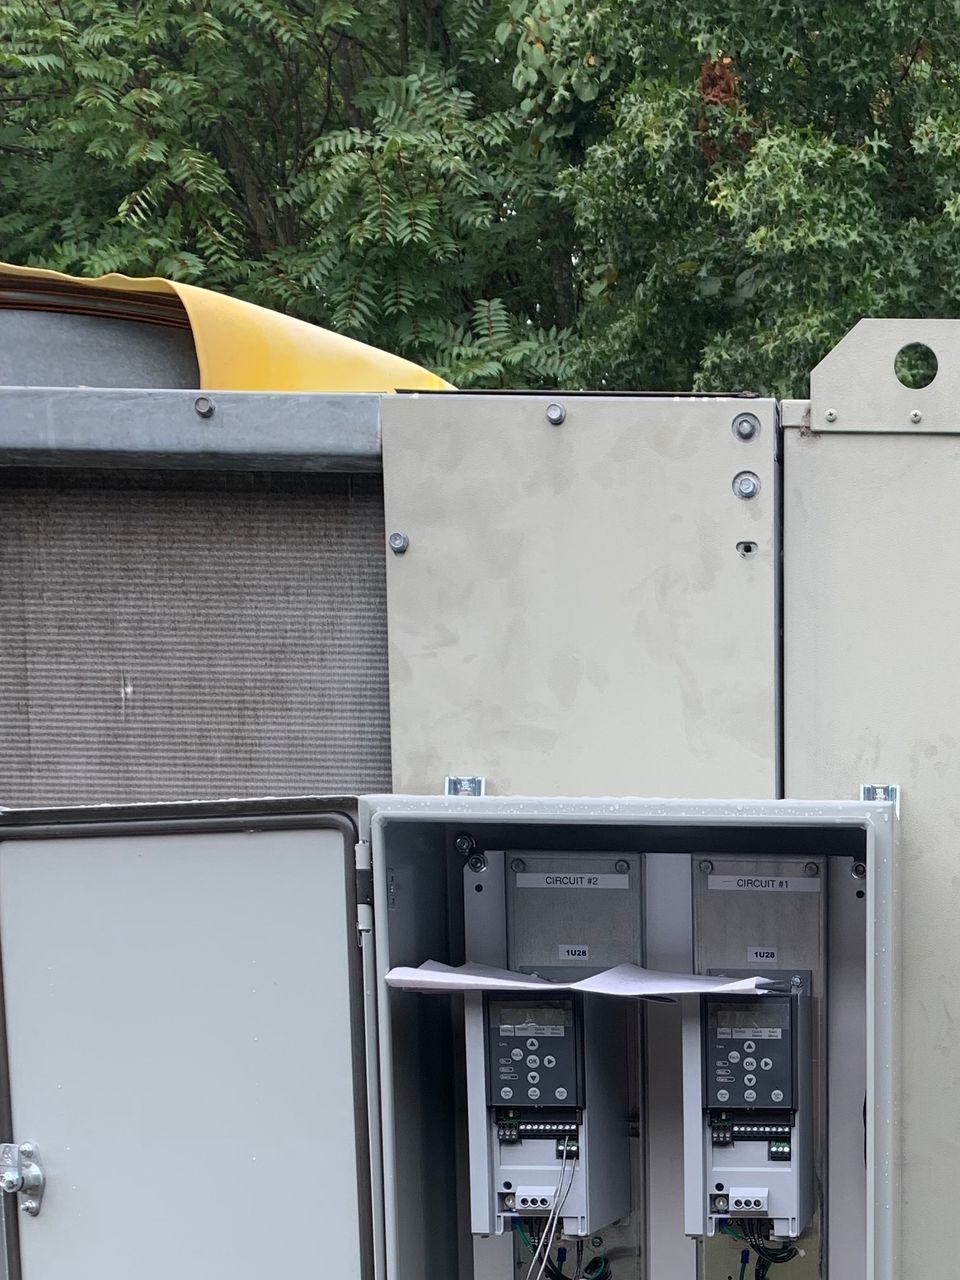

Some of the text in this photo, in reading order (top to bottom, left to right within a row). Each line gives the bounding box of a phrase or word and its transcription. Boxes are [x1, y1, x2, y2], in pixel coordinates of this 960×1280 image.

[545, 876, 598, 886] CIRCUIT #2
[737, 879, 788, 889] CIRCUIT #1
[566, 949, 587, 957] 1U28
